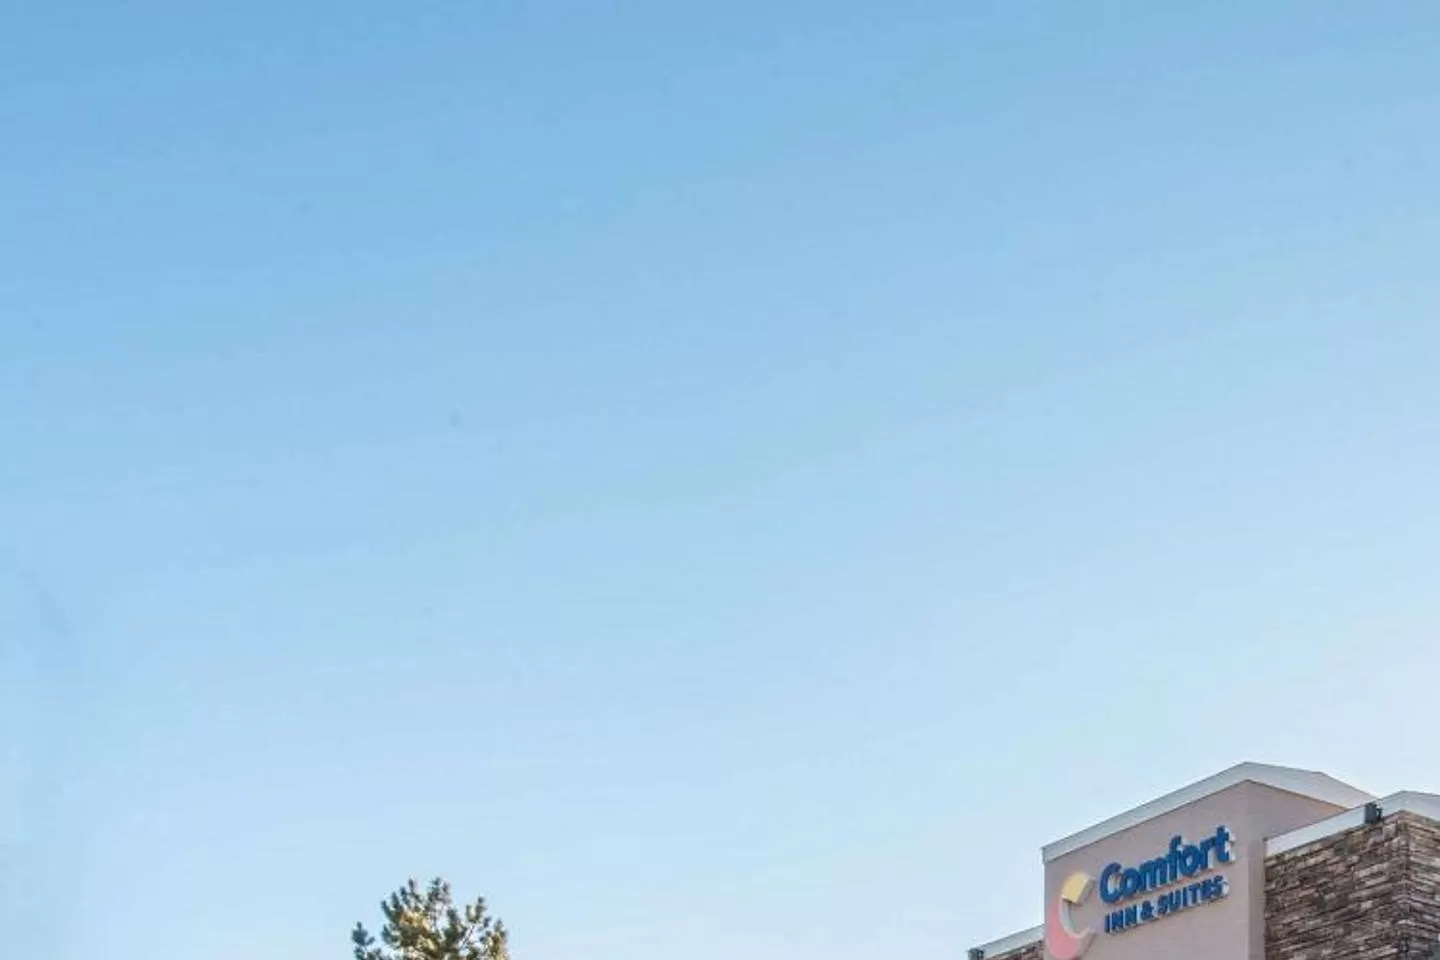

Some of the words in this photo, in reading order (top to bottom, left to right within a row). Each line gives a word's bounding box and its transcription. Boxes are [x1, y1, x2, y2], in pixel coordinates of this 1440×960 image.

[1099, 825, 1234, 904] Comfort
[1105, 903, 1141, 934] INN
[1140, 900, 1155, 921] &
[1158, 875, 1228, 915] SUITES
